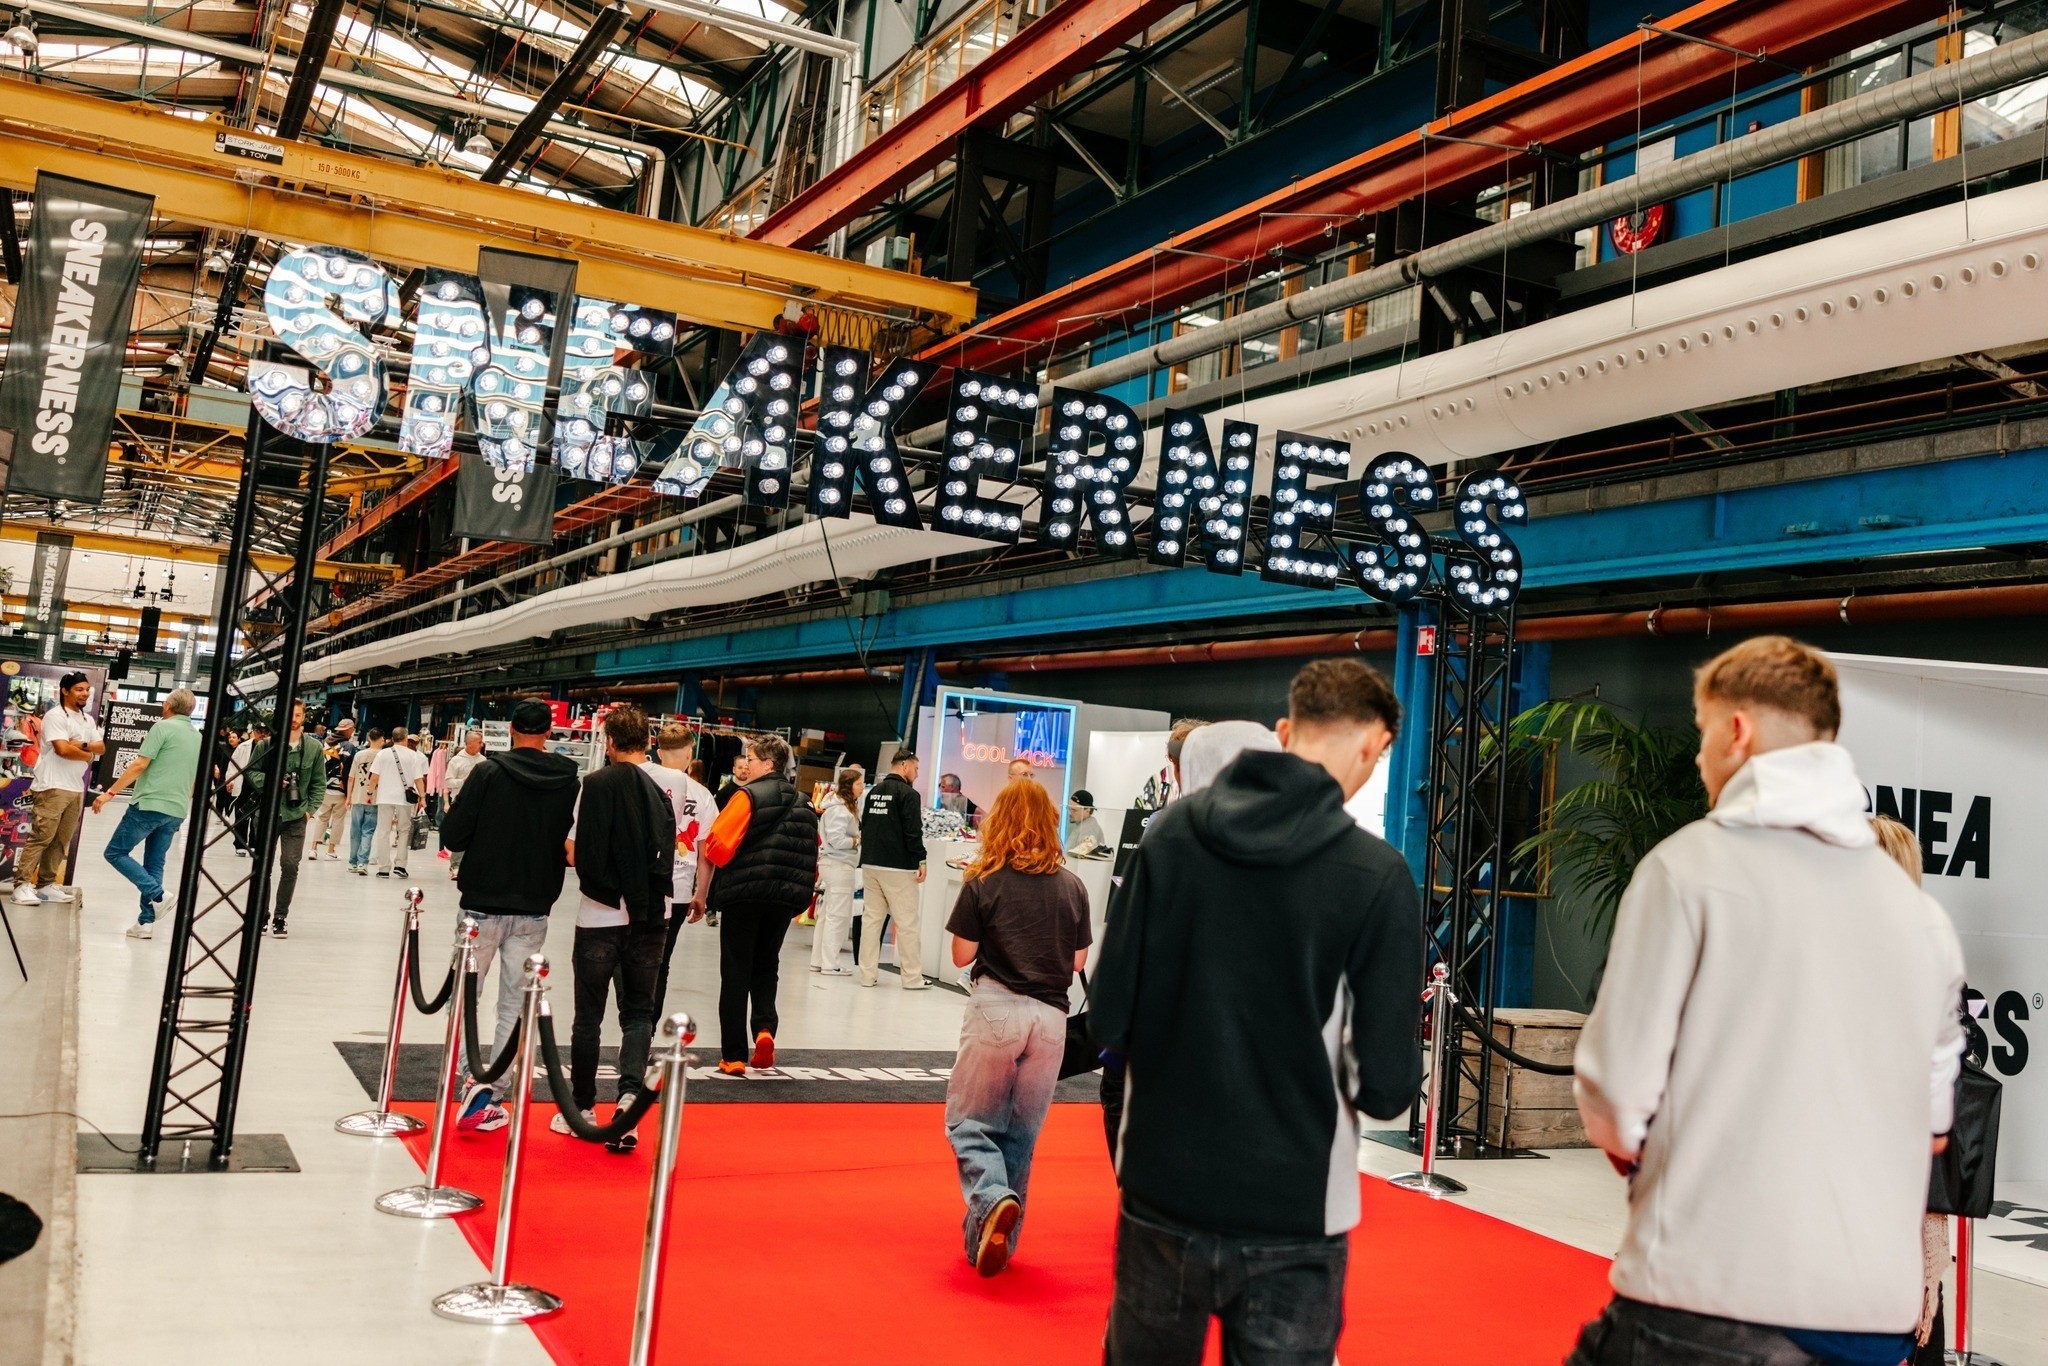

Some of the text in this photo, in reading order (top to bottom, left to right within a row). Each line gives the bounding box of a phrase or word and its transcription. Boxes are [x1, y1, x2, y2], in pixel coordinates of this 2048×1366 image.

[250, 149, 269, 160] TON
[248, 245, 1529, 615] SNEAKERNESS
[112, 706, 142, 714] BECOME
[963, 743, 1011, 764] COOL
